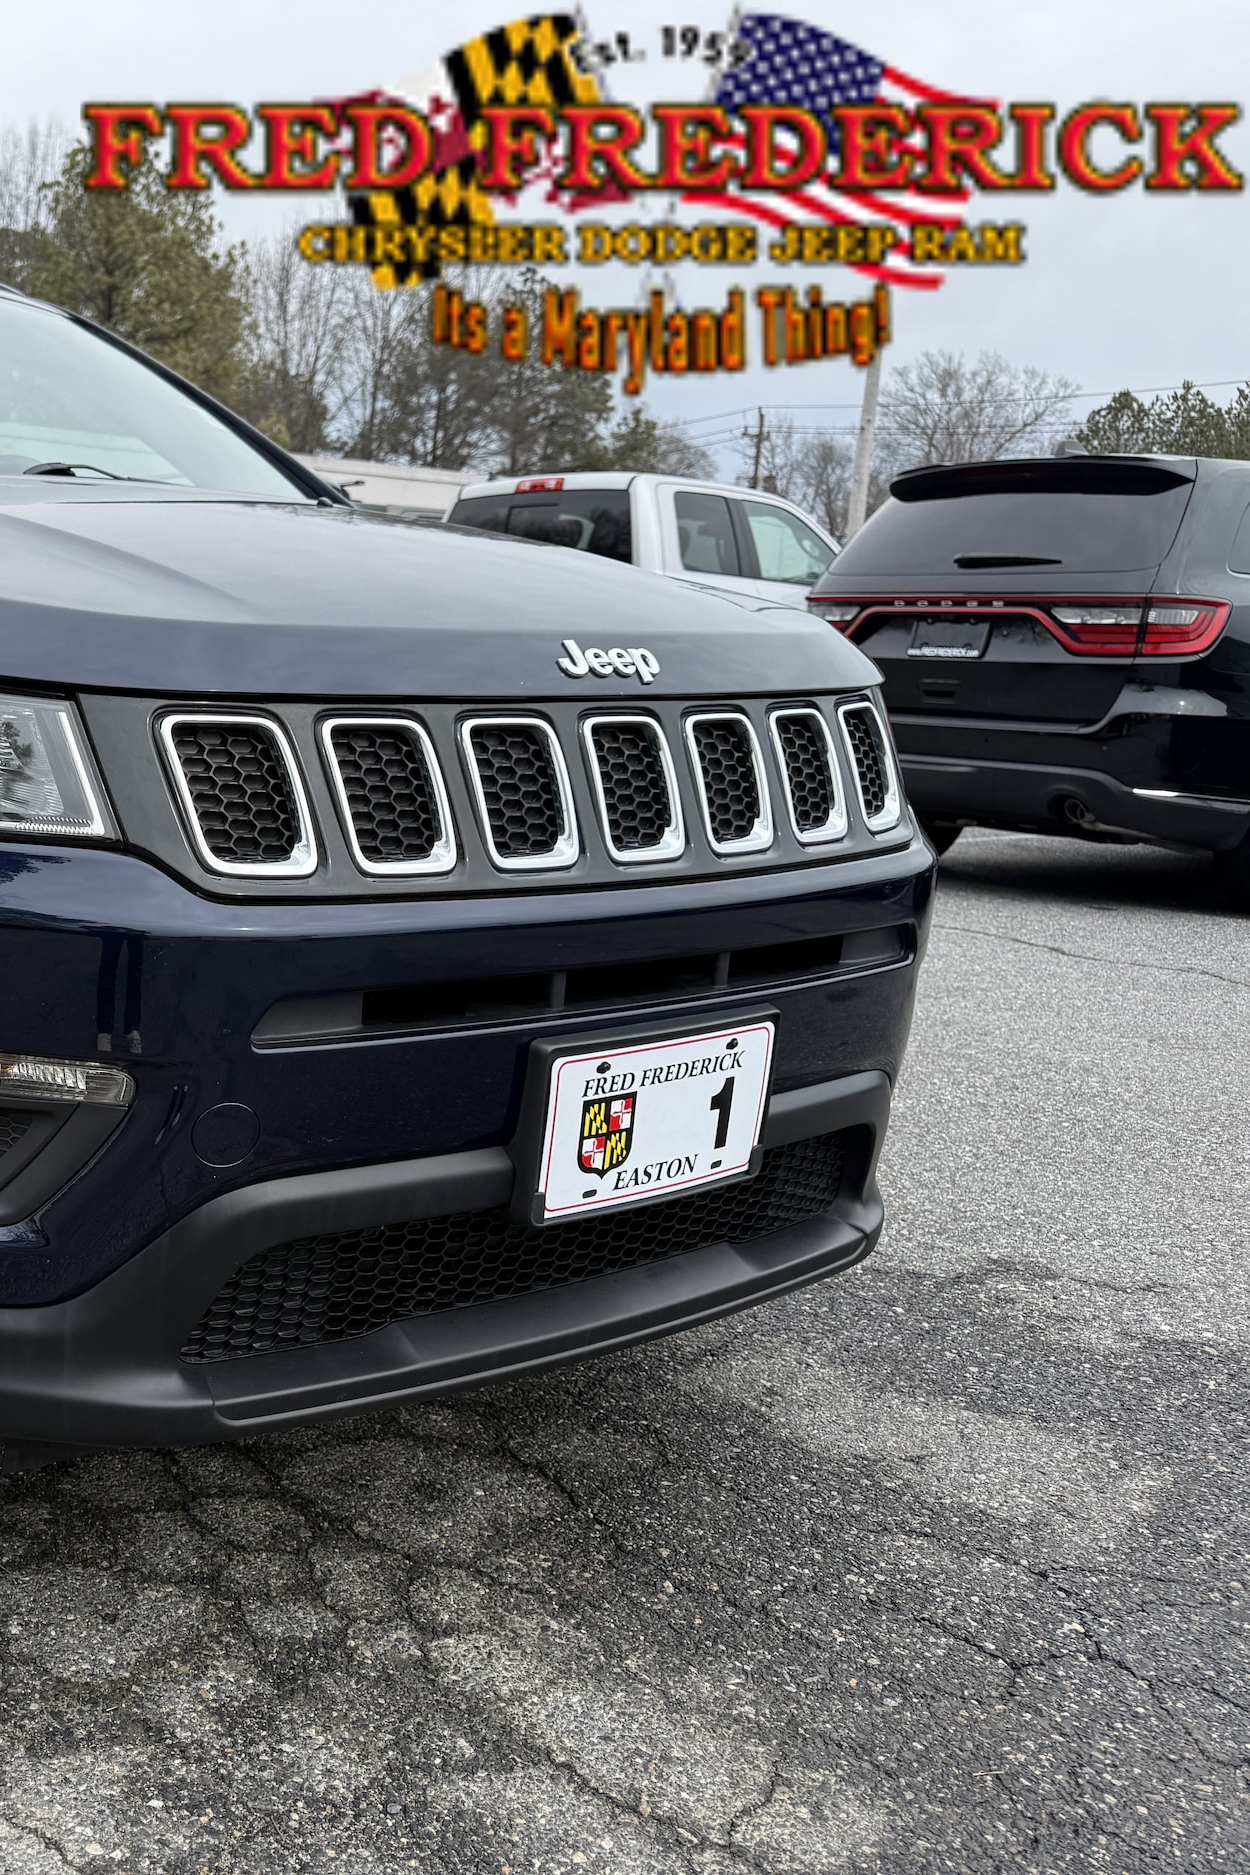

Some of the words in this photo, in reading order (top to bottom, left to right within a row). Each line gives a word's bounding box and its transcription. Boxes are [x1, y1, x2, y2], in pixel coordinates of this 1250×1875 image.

[893, 600, 1005, 608] DODGE
[556, 639, 661, 685] Jeep
[581, 1072, 635, 1098] FRED
[639, 1050, 745, 1088] FREDERICK
[709, 1076, 735, 1150] 1
[612, 1153, 699, 1192] EASTON
